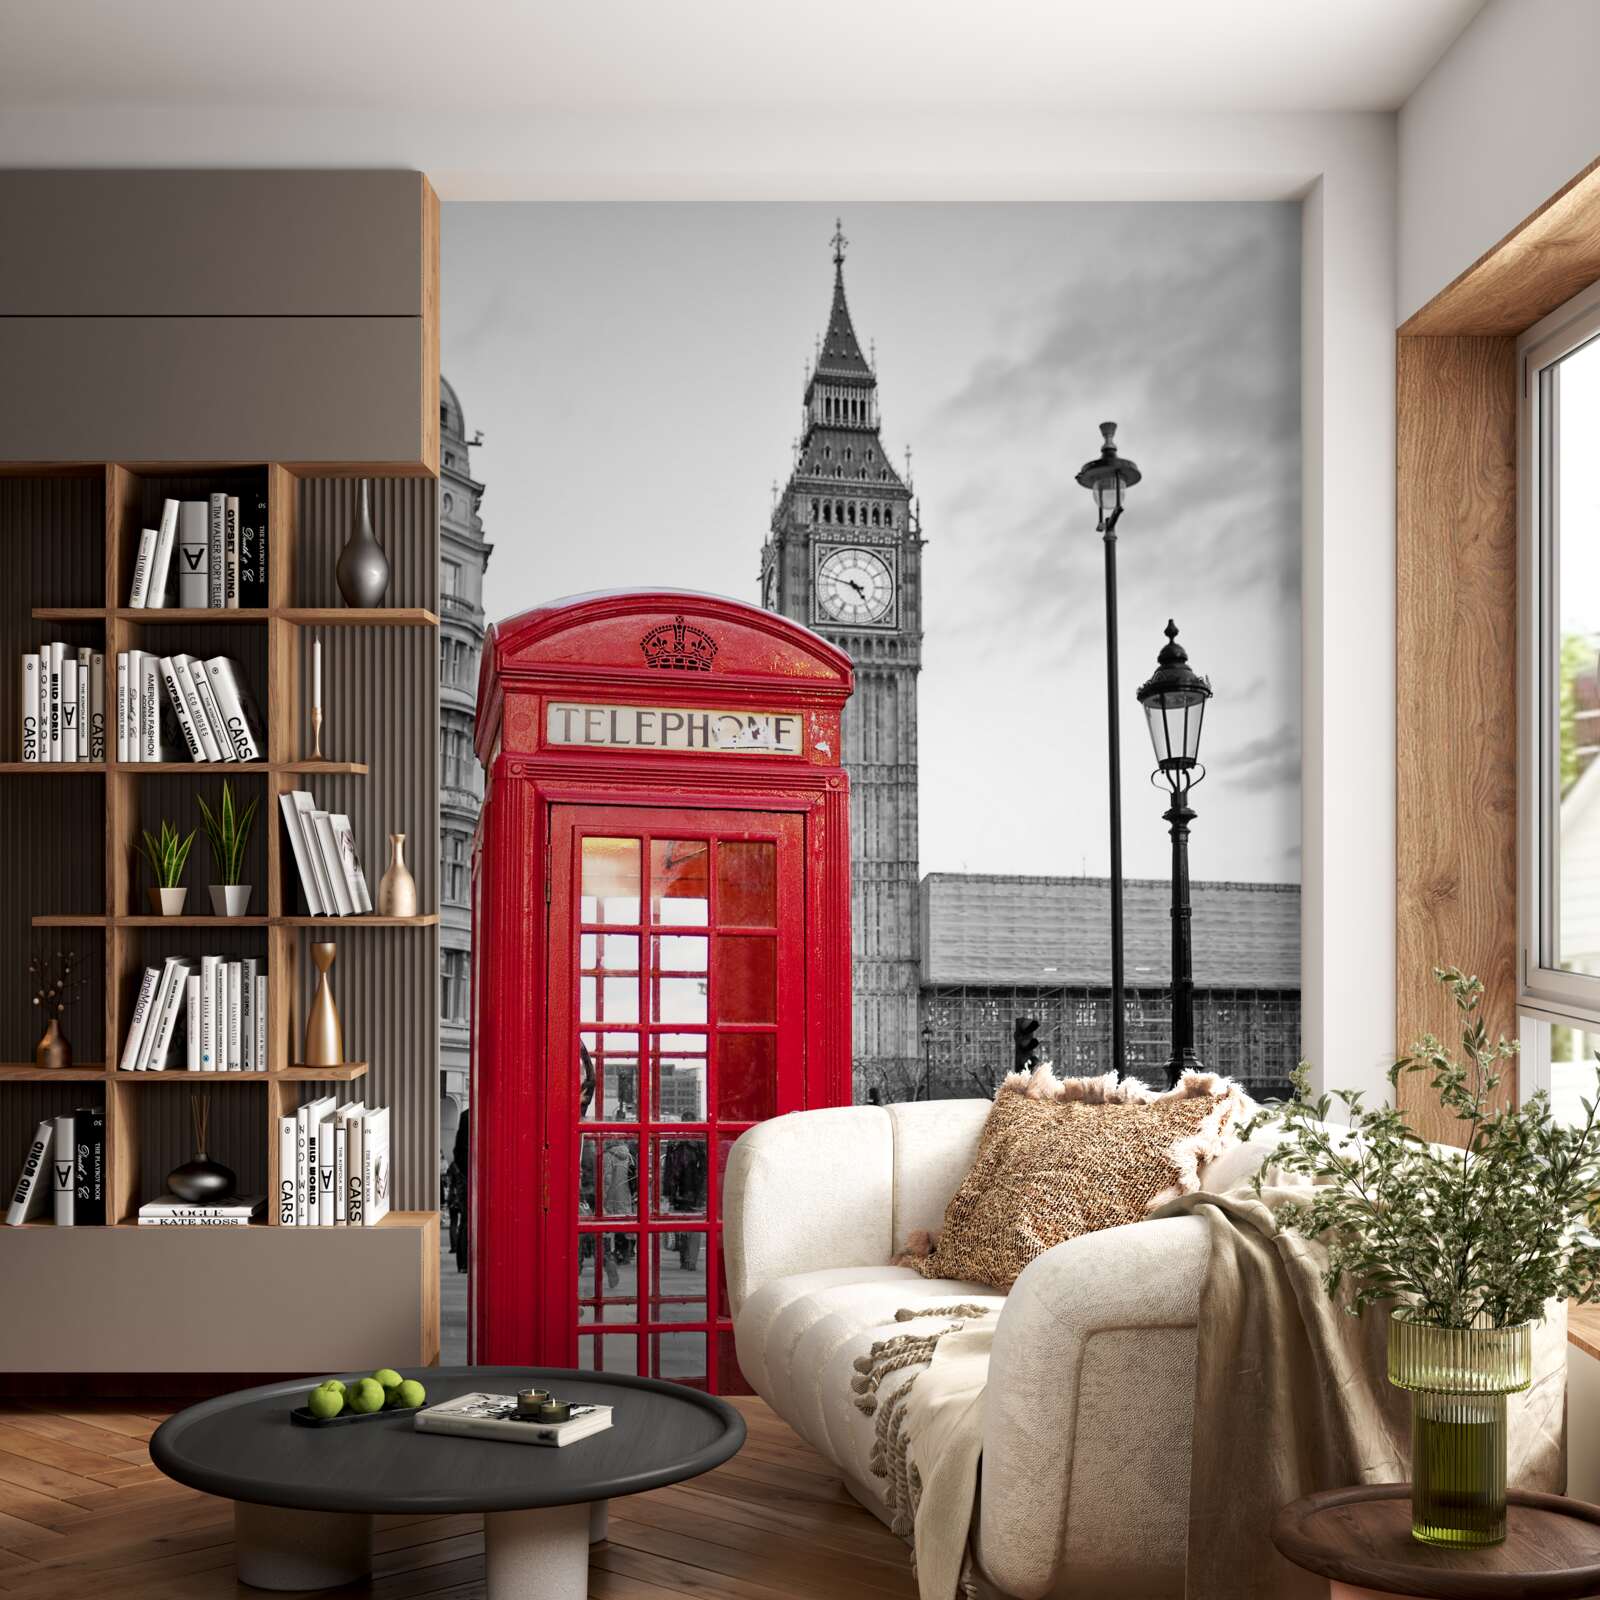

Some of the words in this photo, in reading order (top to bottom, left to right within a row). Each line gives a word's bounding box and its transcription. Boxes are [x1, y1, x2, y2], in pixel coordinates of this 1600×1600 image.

[213, 506, 221, 519] TIM
[213, 522, 221, 554] WALKER
[183, 548, 204, 570] A
[213, 556, 221, 581] STORY
[213, 583, 221, 607] TELLER
[64, 707, 74, 726] A
[166, 676, 184, 714] GYPSET
[182, 721, 199, 755] LIVING
[187, 692, 199, 706] ECO
[194, 710, 208, 737] HOUSES
[24, 717, 36, 760] CARS
[92, 713, 104, 758] CARS
[227, 717, 253, 759] CARS
[14, 1179, 31, 1204] WILD
[24, 1141, 44, 1177] WORLD
[56, 1165, 71, 1188] A
[321, 1170, 332, 1190] A
[170, 1209, 224, 1217] VOGUE
[281, 1180, 293, 1223] CARS
[350, 1177, 361, 1221] CARS
